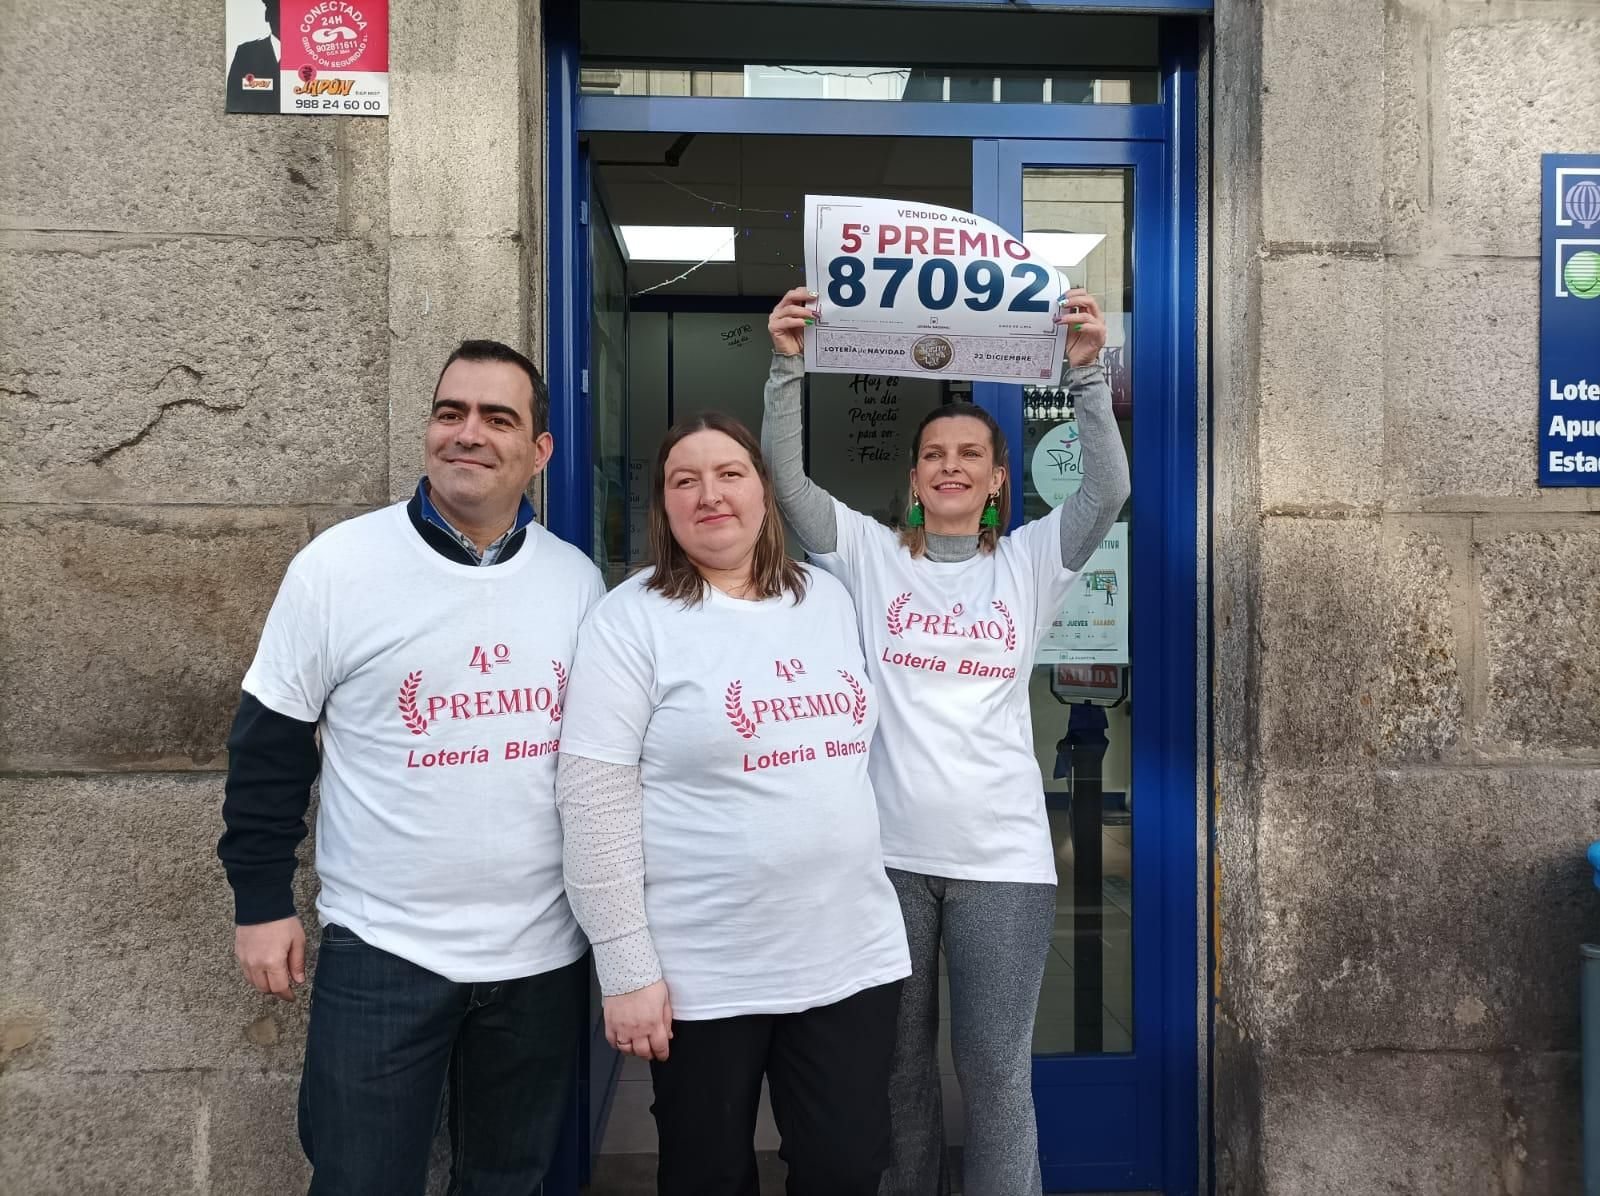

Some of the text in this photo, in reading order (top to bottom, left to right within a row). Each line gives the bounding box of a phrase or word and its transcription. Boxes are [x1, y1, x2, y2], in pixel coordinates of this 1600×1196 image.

[300, 1, 368, 33] CONECTADA
[321, 15, 343, 26] 24H
[302, 36, 318, 60] GRUPO
[331, 42, 366, 68] SEGURIDAD
[295, 99, 381, 110] 988 24 60 00
[897, 208, 948, 222] VENDIDO
[878, 224, 1032, 261] PREMIO
[827, 255, 1050, 313] 87092
[867, 347, 906, 355] NAVIDAD
[974, 353, 1032, 362] 22 DICIEMBRE
[849, 374, 899, 394] Hoy es
[864, 395, 876, 405] un
[848, 407, 899, 427] Perfecto
[856, 430, 877, 444] para
[856, 446, 891, 464] Feliz
[1549, 450, 1600, 473] Esta
[905, 612, 1005, 640] PREMIO
[882, 647, 1016, 680] Lotería Blanca
[427, 687, 553, 722] PREMIO
[751, 691, 851, 724] PREMIO
[407, 738, 560, 769] Lotería Blanca
[743, 740, 867, 773] Lotería Blanca
